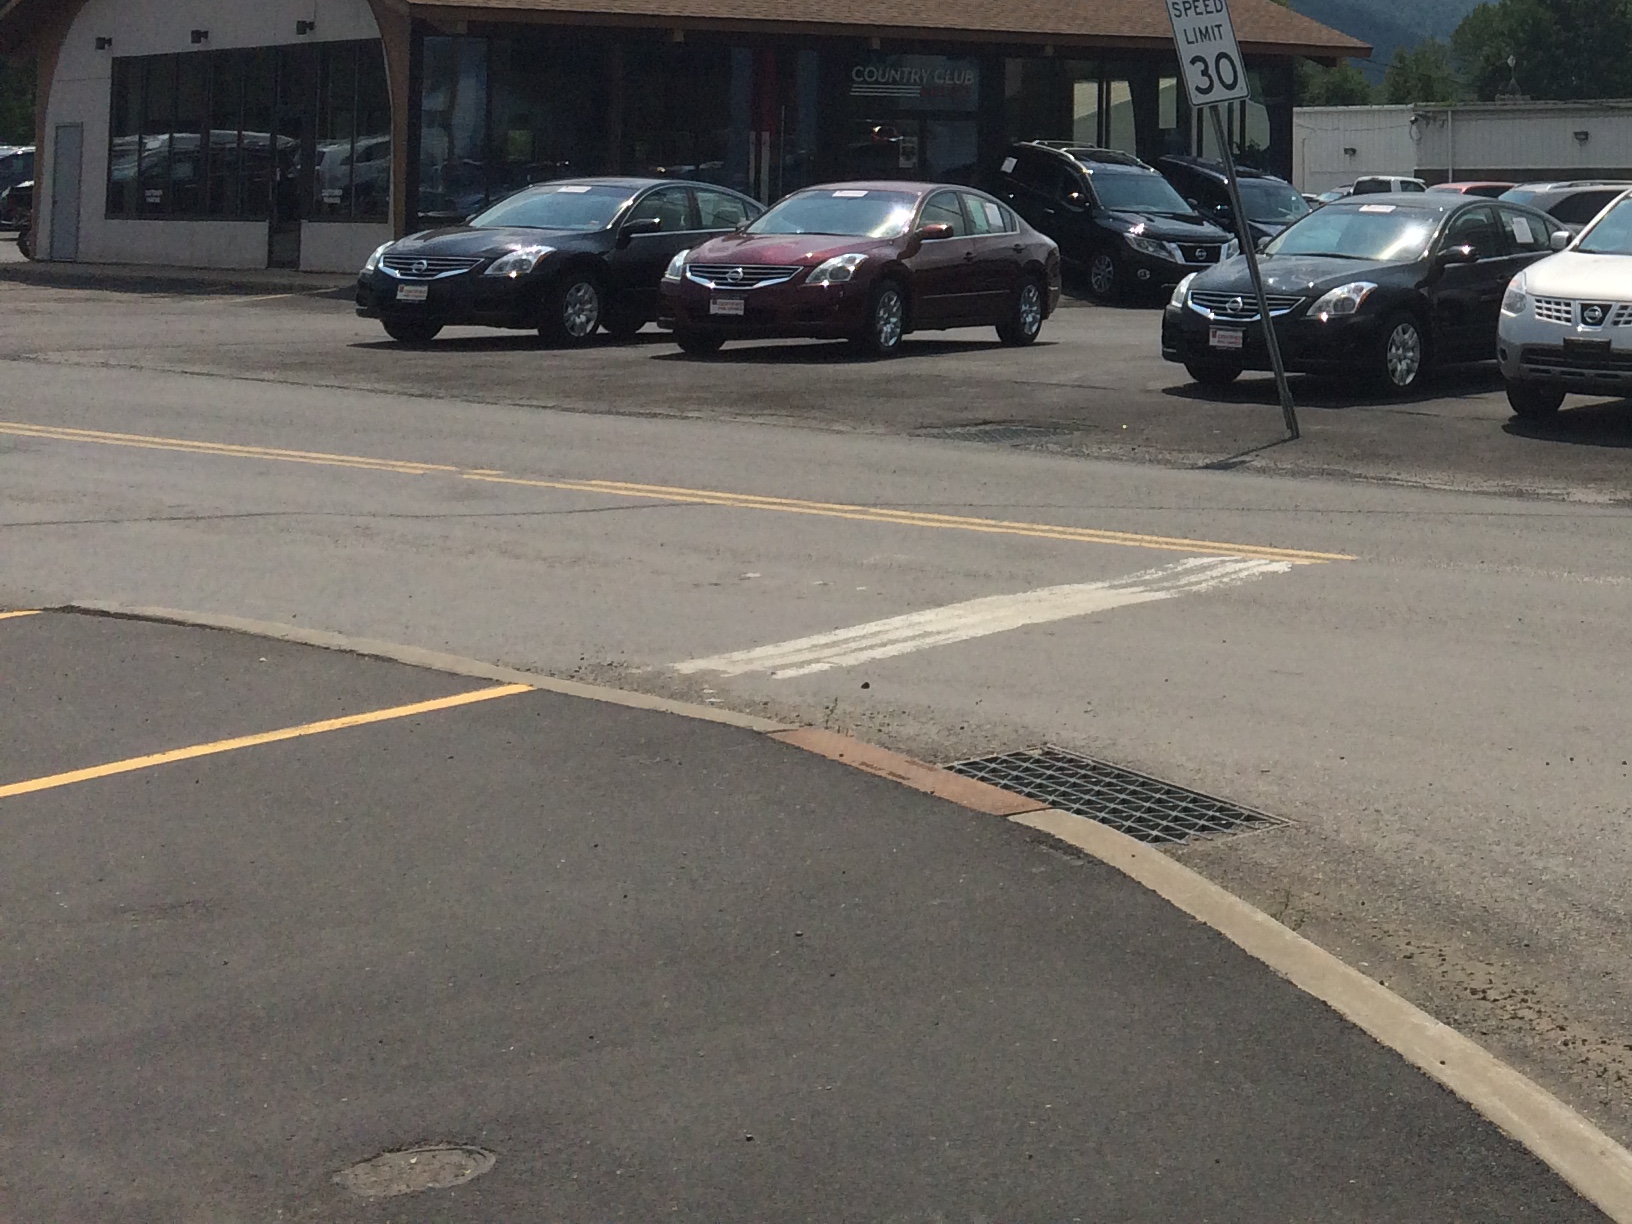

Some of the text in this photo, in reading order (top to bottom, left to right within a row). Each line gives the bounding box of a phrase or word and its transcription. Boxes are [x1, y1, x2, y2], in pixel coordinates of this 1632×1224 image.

[1183, 24, 1223, 45] LIMIT
[851, 65, 976, 85] COUNTRY CLUB
[1189, 51, 1239, 95] 30
